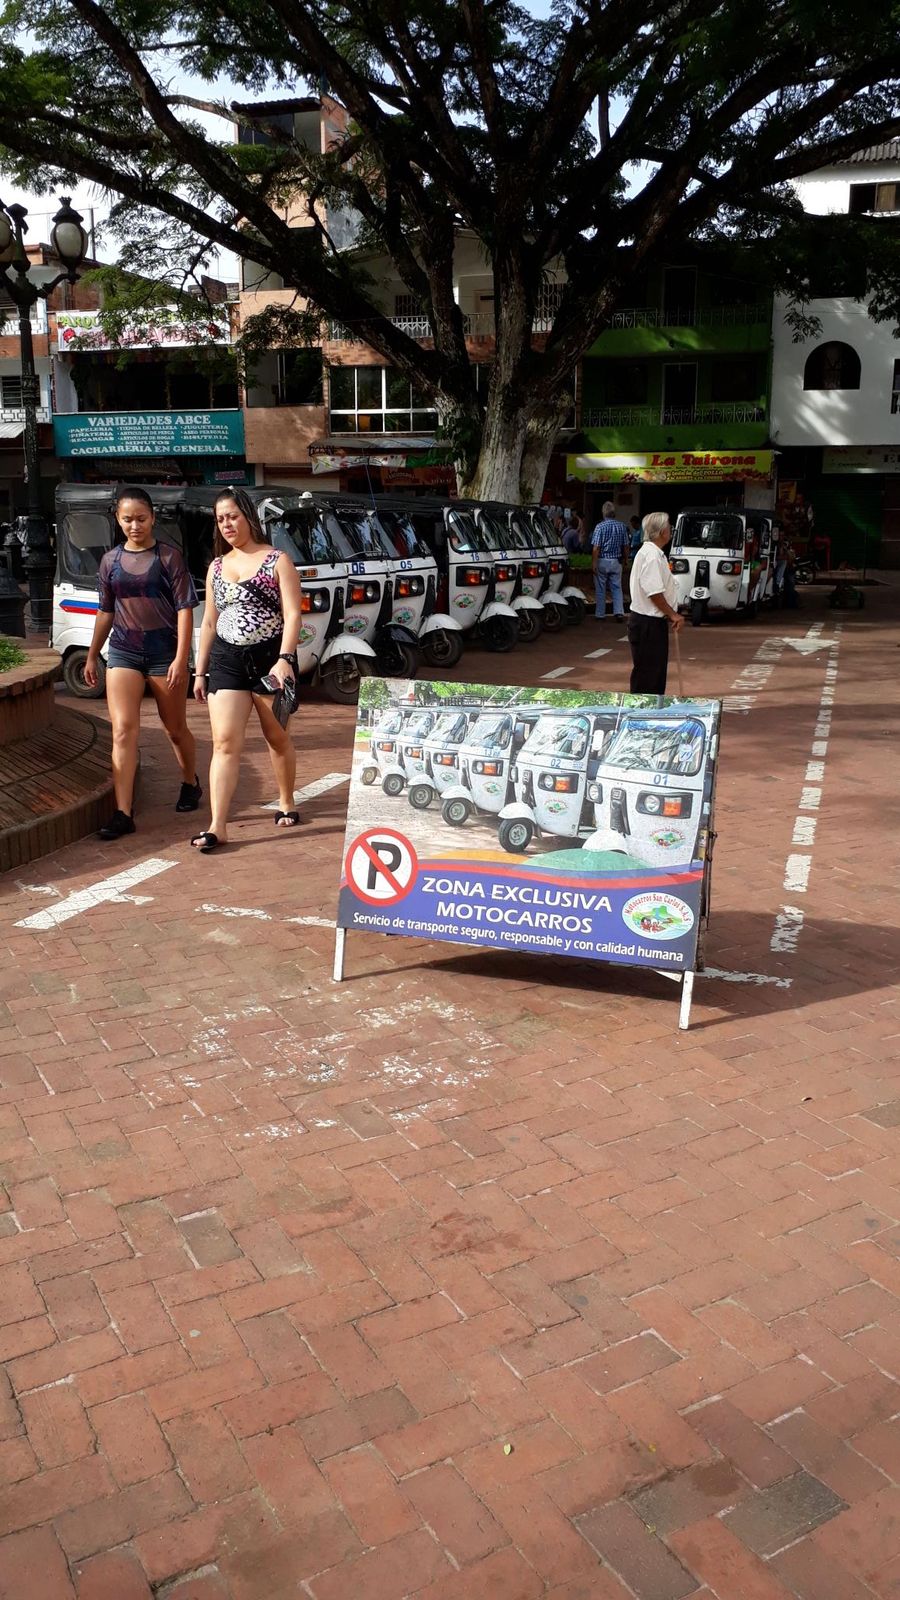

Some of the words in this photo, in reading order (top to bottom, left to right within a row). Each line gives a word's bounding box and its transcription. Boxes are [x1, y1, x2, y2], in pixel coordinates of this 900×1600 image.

[88, 415, 172, 426] VARIEDADES
[175, 415, 211, 425] ABCE
[71, 446, 152, 455] CACHARRERIA
[652, 454, 676, 466] La
[682, 453, 756, 466] Tairona
[351, 562, 366, 574] 06
[400, 560, 413, 569] 05
[550, 758, 562, 768] 02
[653, 775, 669, 788] 01
[422, 876, 485, 898] ZONA
[491, 884, 613, 913] EXCLUSIVA
[653, 893, 663, 903] San
[664, 894, 681, 908] Carlos
[436, 902, 593, 934] MOTOCARROS
[353, 912, 391, 926] Servicio
[392, 918, 406, 928] de
[407, 919, 459, 936] transporte
[461, 927, 498, 943] seguro,
[500, 931, 563, 948] responsable
[564, 939, 571, 950] y
[573, 940, 594, 951] con
[596, 942, 635, 957] calidad
[637, 946, 684, 962] humana
